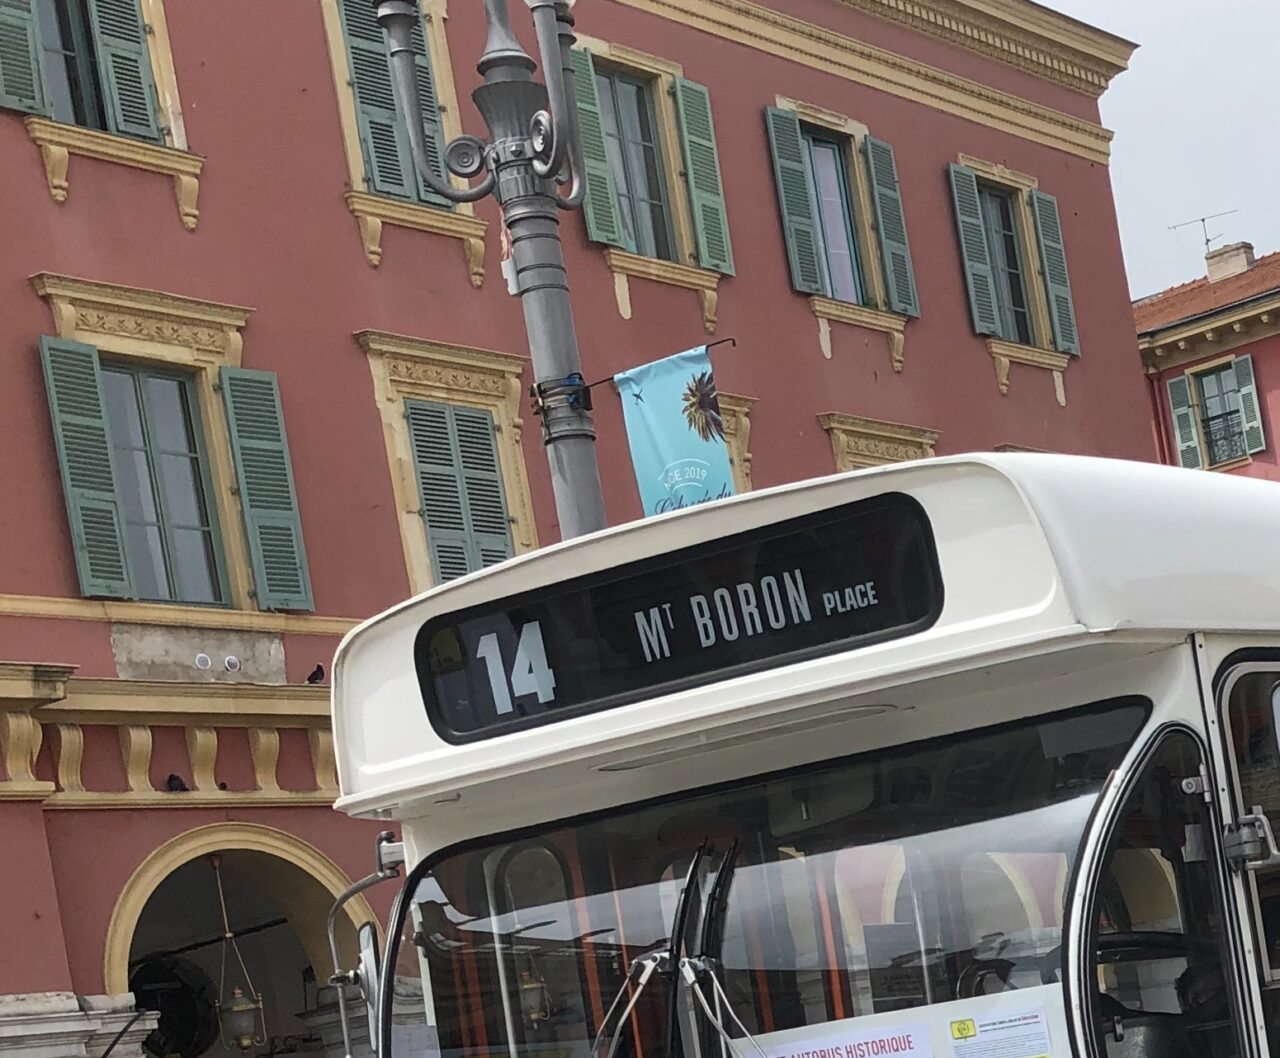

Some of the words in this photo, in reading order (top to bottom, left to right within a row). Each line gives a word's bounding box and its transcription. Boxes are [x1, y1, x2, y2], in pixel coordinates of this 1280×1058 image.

[684, 466, 707, 480] 2019
[475, 620, 556, 716] 14
[689, 569, 812, 649] BORON
[822, 581, 879, 617] PLACE
[845, 1034, 914, 1058] HISTORIQUE
